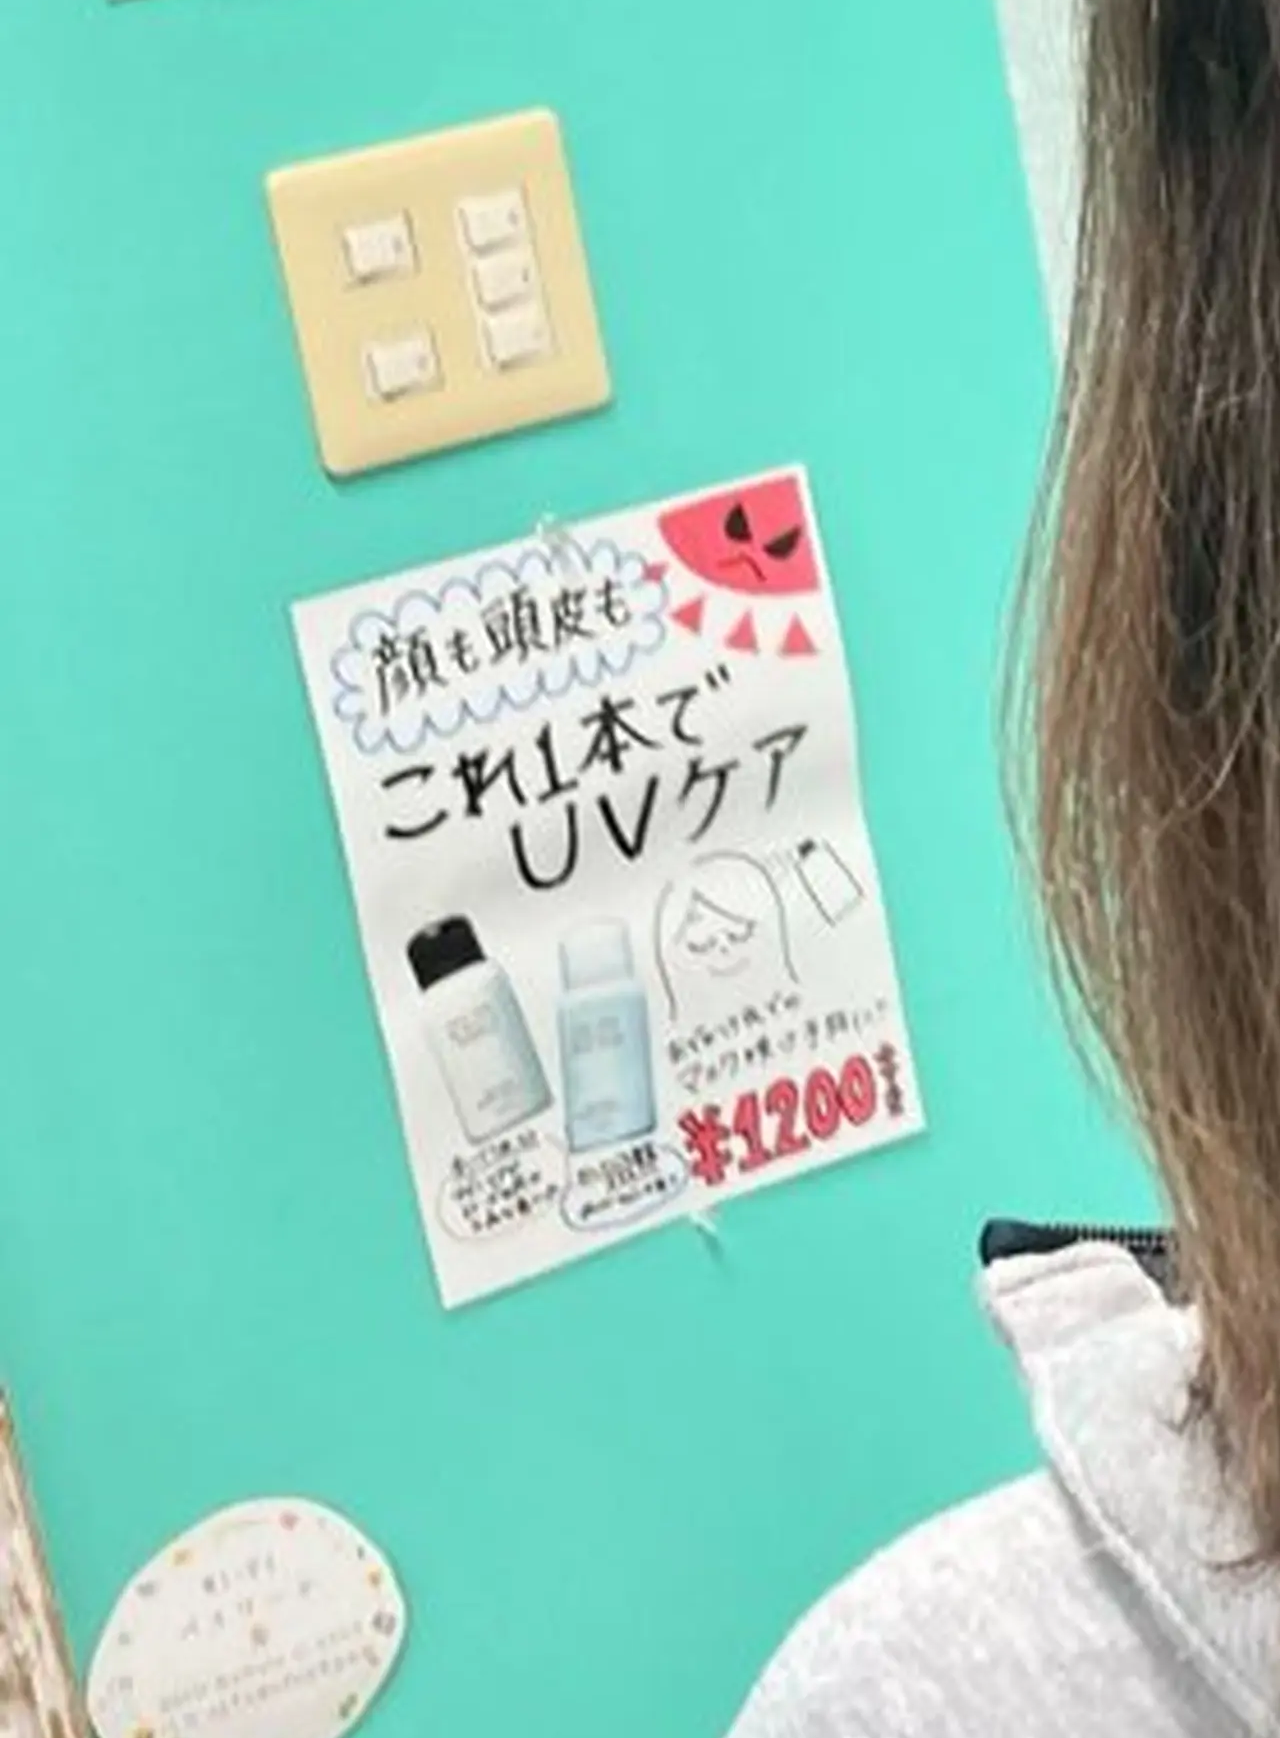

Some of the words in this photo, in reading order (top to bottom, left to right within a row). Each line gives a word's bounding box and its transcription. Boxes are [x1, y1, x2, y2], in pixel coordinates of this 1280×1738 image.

[371, 577, 633, 715] 顔も頭皮も
[509, 724, 809, 890] UVケア
[678, 1053, 877, 1186] ¥1200
